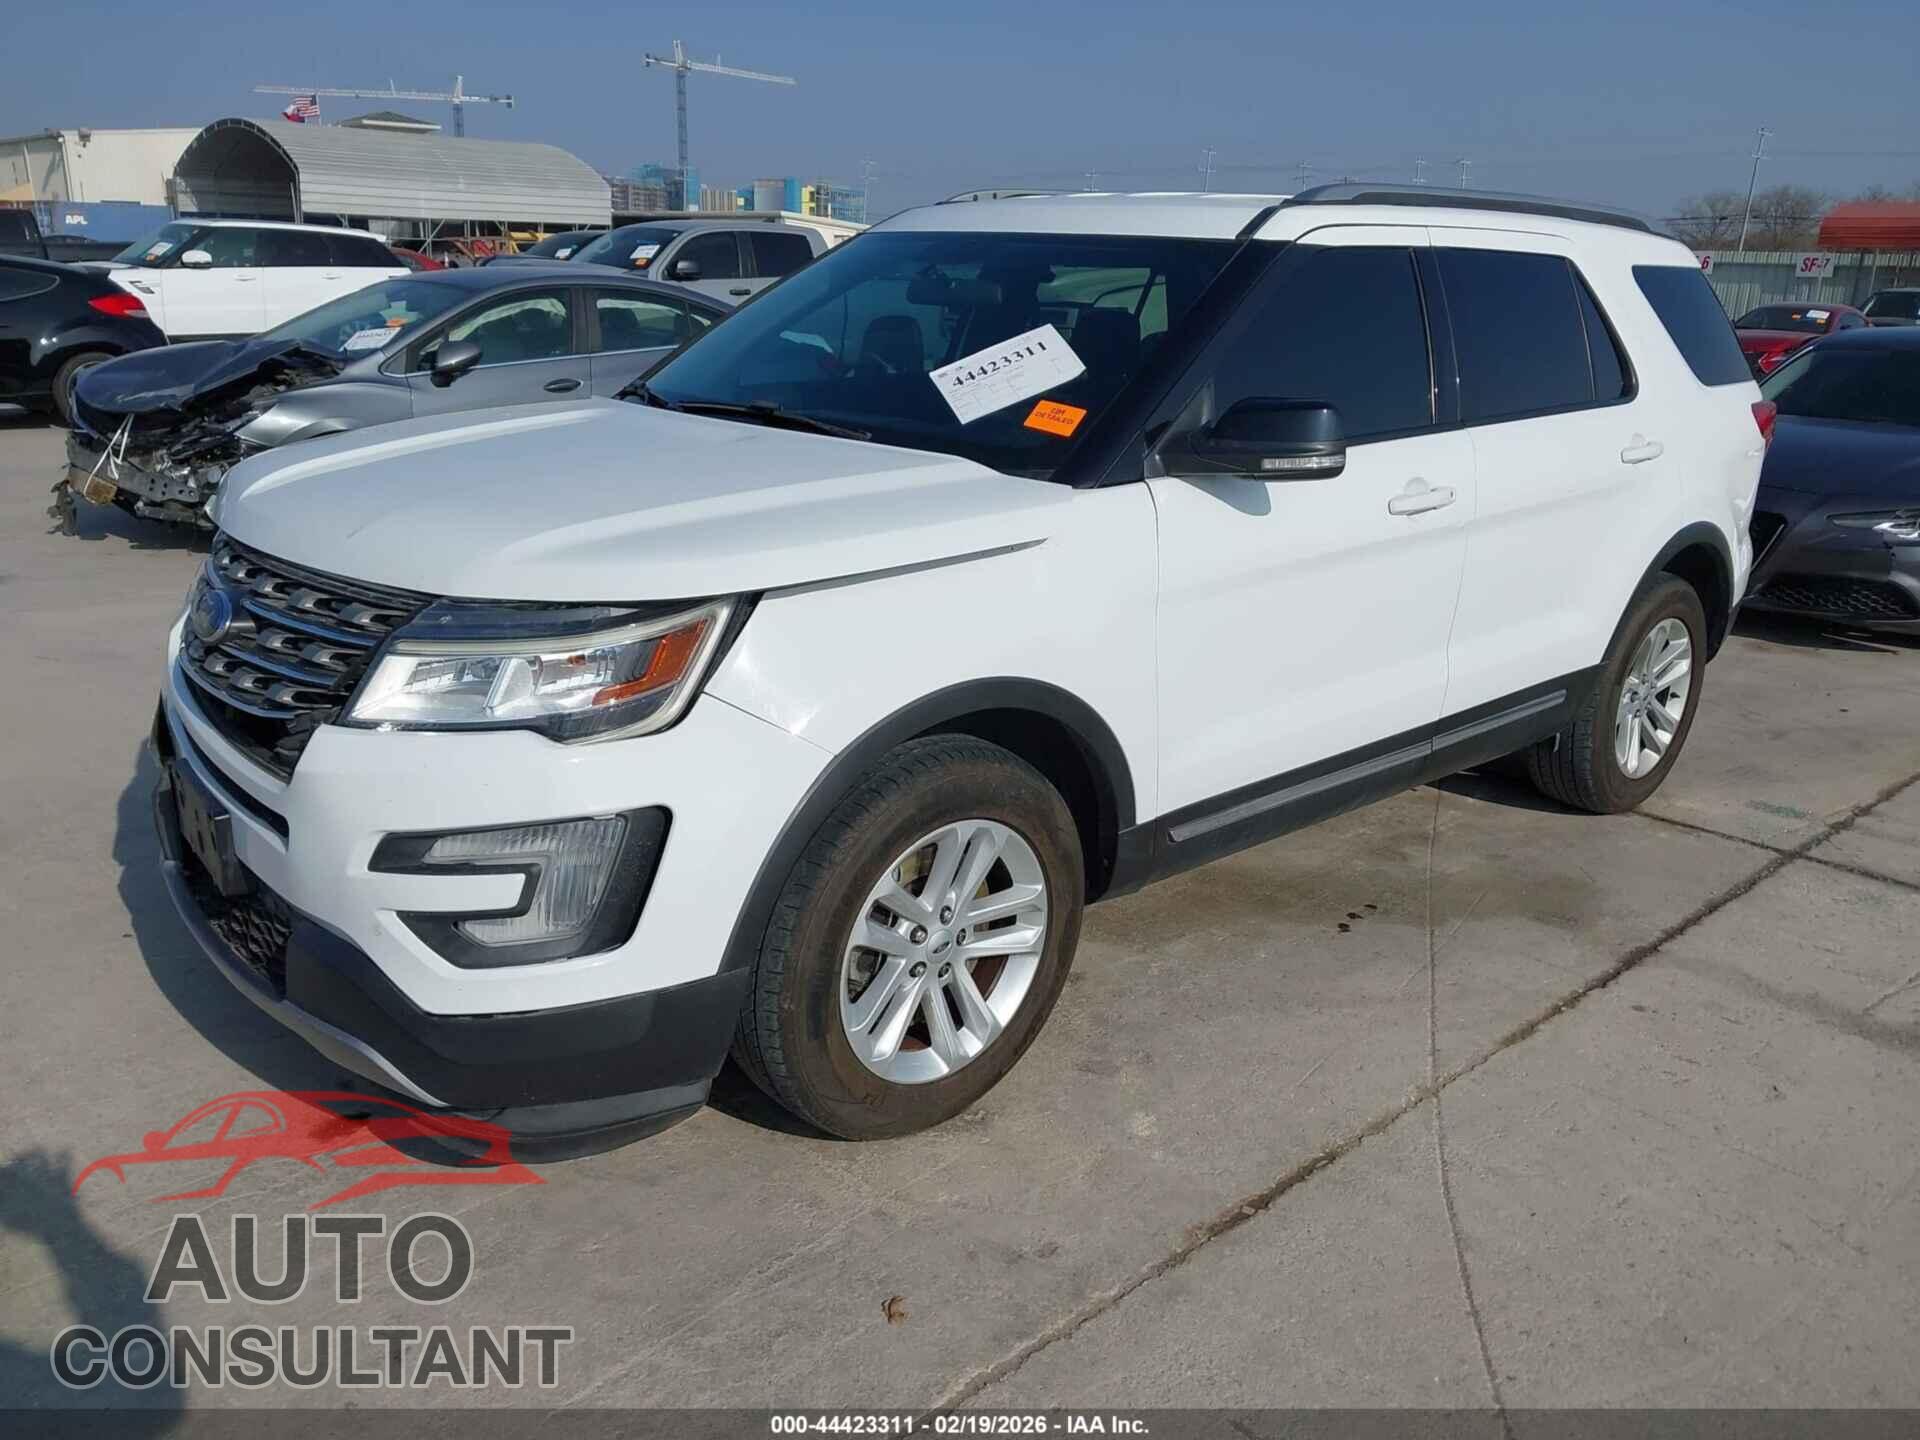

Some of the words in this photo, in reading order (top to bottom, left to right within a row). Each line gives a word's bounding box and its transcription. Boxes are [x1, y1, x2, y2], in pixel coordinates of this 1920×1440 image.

[65, 215, 88, 225] APL
[1801, 256, 1831, 273] SF-7
[952, 341, 1048, 387] 44423311
